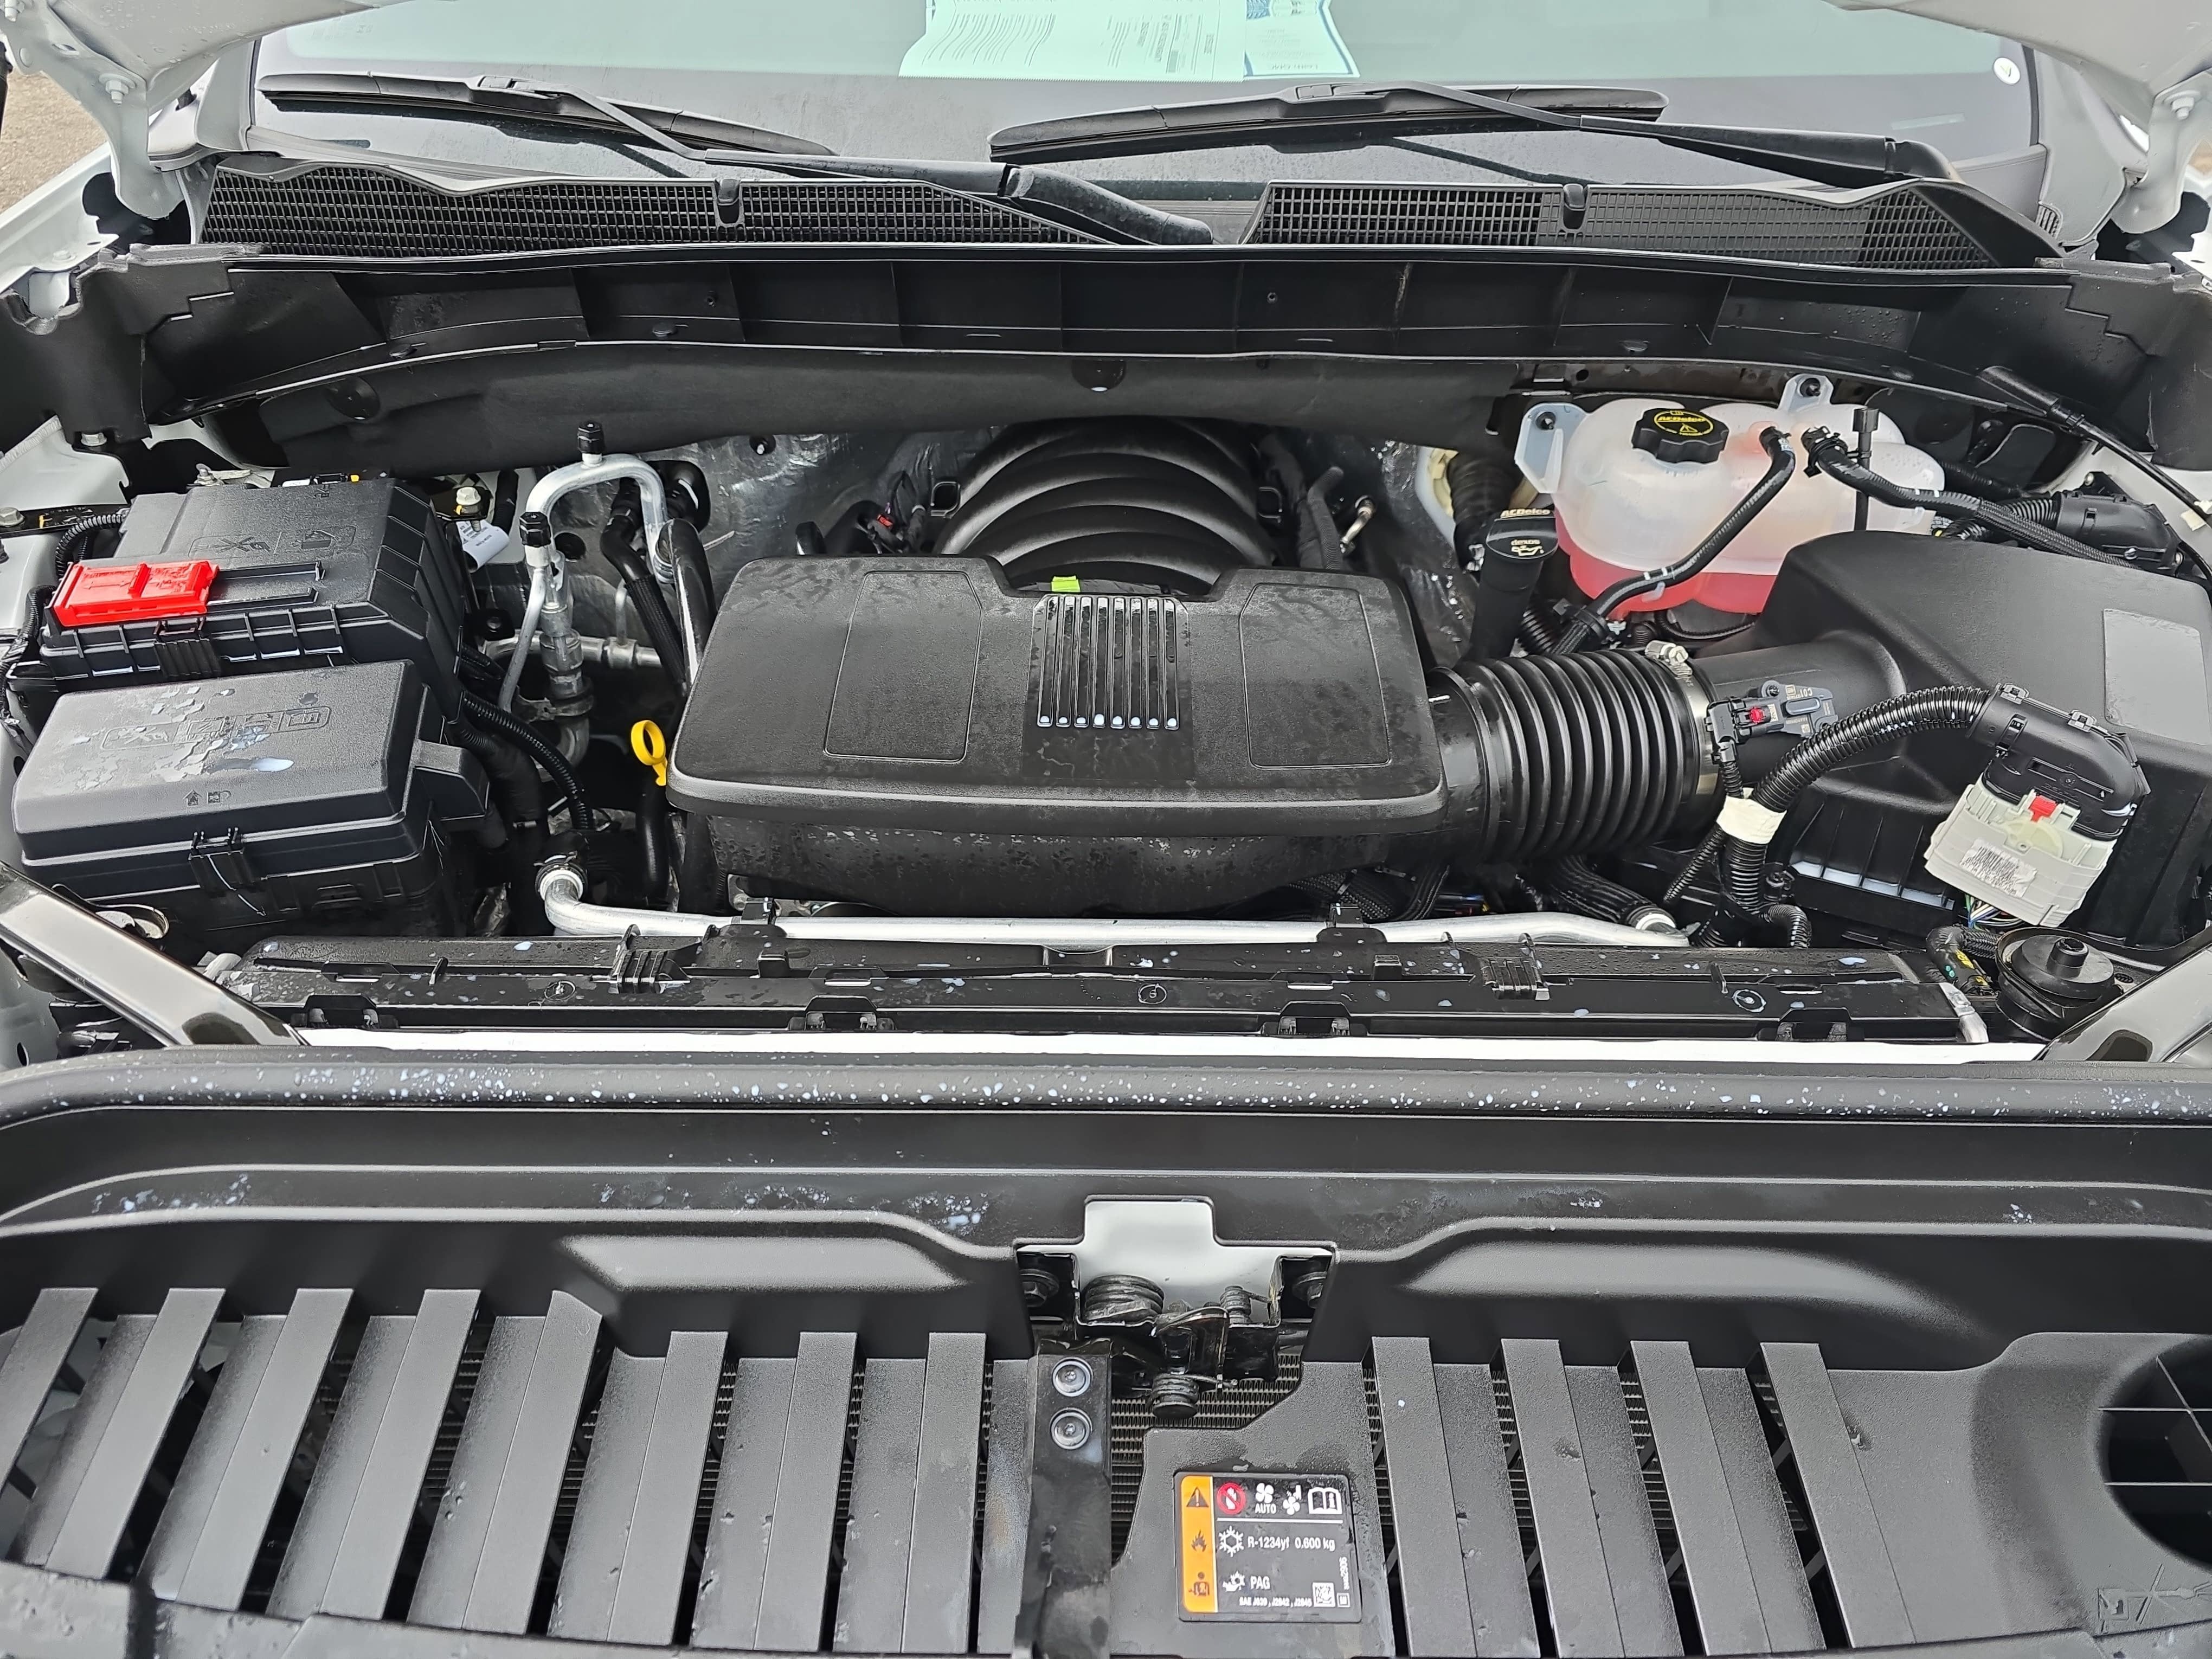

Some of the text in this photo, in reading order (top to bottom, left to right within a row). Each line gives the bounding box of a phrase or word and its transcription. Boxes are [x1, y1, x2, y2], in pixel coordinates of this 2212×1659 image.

[1500, 508, 1551, 518] ACDelco
[1255, 1503, 1276, 1514] AUTO
[1248, 1536, 1290, 1551] R-1234yf
[1323, 1537, 1335, 1552] kg
[1250, 1576, 1271, 1590] PAG
